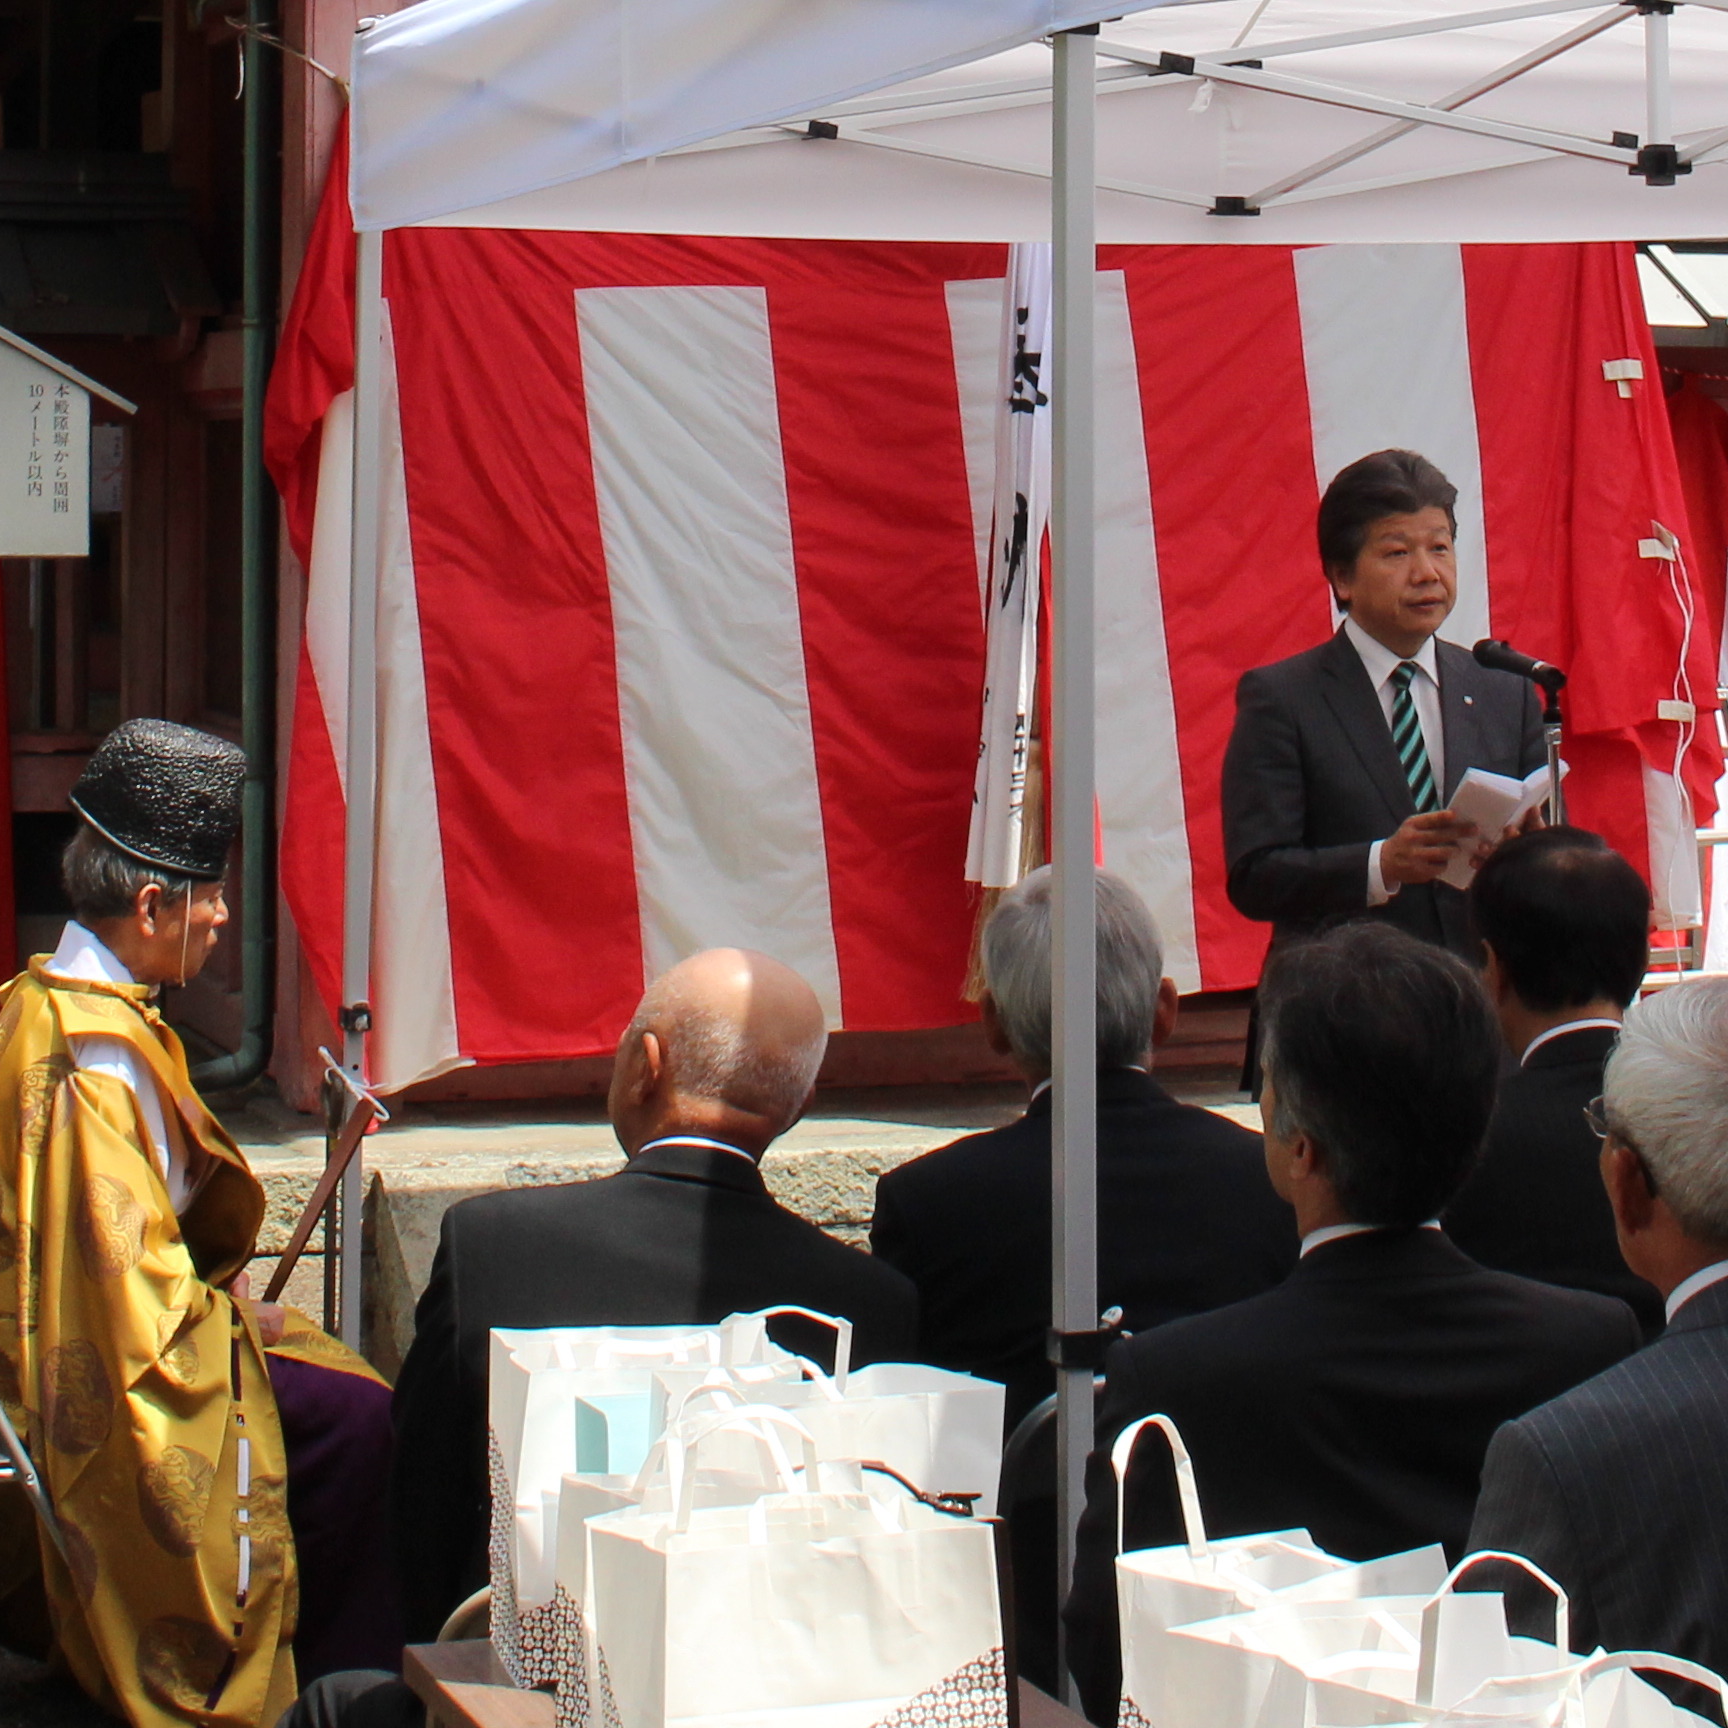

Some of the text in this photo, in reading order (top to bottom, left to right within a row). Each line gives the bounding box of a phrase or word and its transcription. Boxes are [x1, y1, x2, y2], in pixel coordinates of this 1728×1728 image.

[27, 384, 44, 497] 10メートル以内
